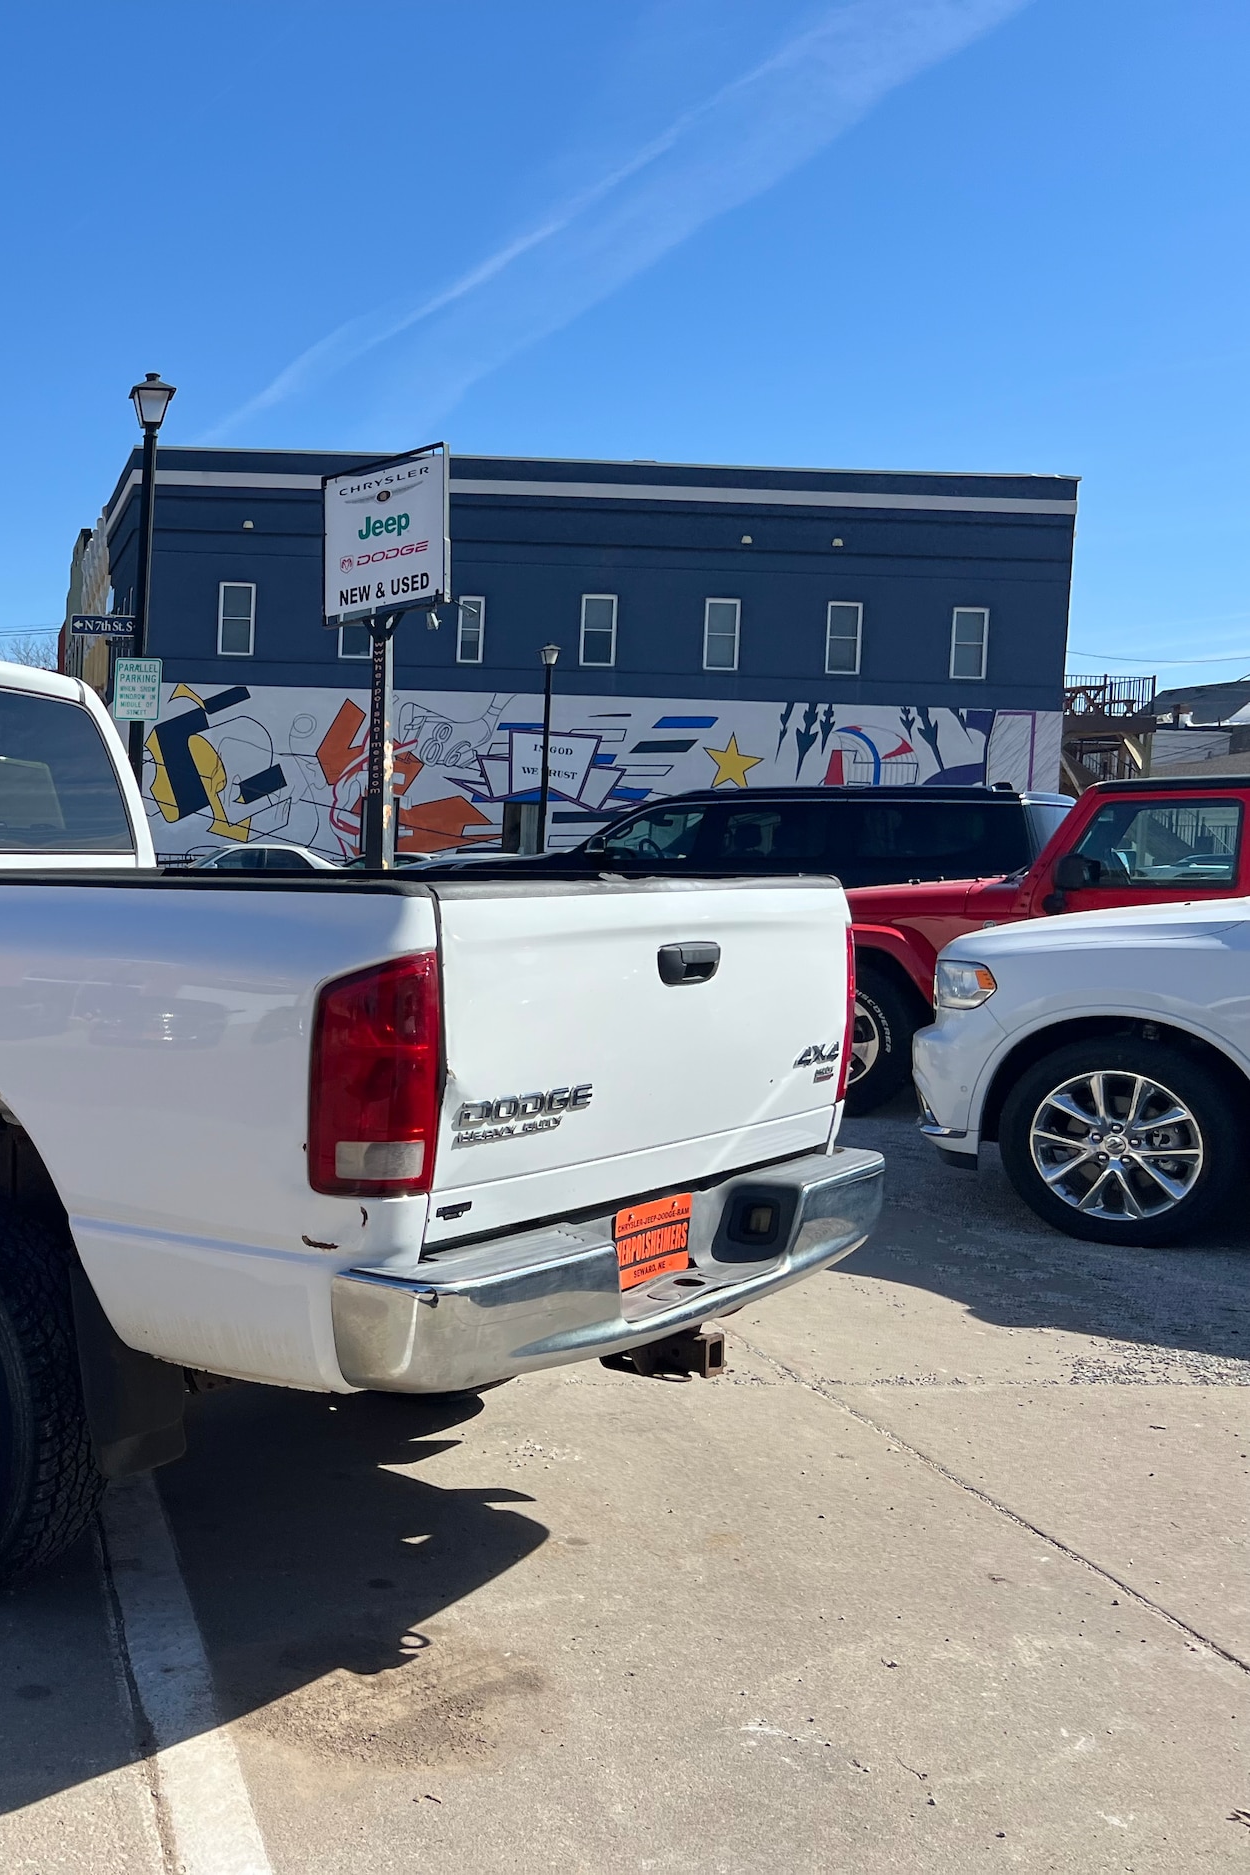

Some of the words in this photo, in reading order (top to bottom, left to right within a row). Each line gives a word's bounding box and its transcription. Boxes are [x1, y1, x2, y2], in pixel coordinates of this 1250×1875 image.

[339, 466, 429, 496] CHRYSLER
[358, 512, 410, 540] Jeep
[356, 541, 429, 566] DODGE
[339, 584, 371, 606] NEW
[375, 582, 385, 599] &
[391, 572, 429, 596] USED
[84, 620, 95, 631] N
[95, 620, 111, 631] 7th
[113, 620, 125, 631] St.
[119, 663, 158, 673] PARALLEL
[119, 674, 157, 683] PARKING
[419, 722, 472, 768] 86
[549, 745, 574, 756] GOD
[521, 766, 539, 775] WE
[548, 769, 578, 781] RUST
[458, 1083, 593, 1126] DODGE
[457, 1124, 516, 1144] HEAVY
[521, 1115, 563, 1132] DUTY
[658, 1260, 666, 1270] NE
